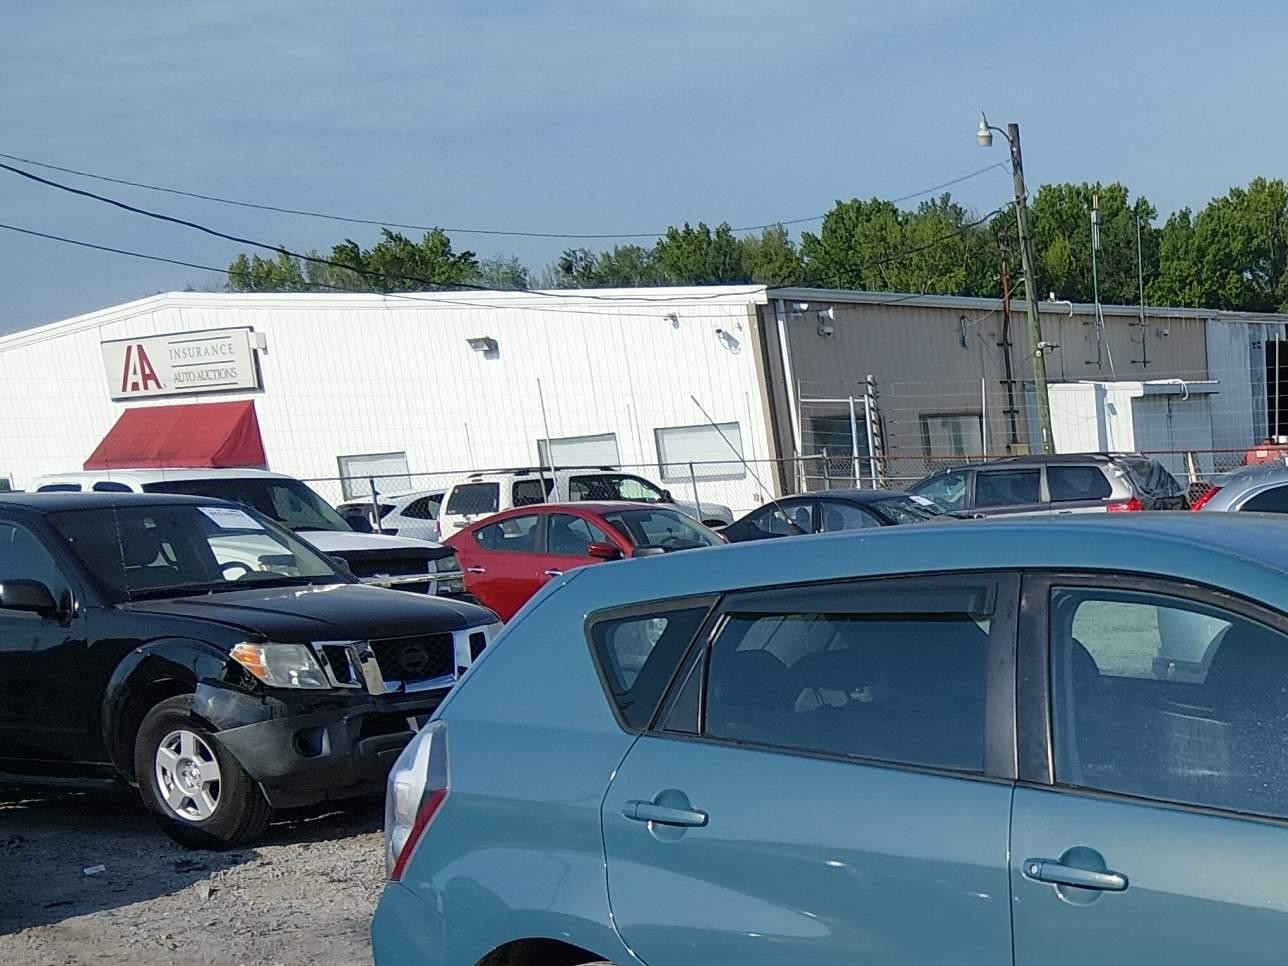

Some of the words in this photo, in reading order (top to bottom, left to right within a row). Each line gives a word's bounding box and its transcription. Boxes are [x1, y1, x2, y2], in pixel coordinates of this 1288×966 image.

[169, 343, 235, 360] INSURANCE
[174, 370, 196, 383] AUTO
[197, 367, 239, 381] AUCTIONS
